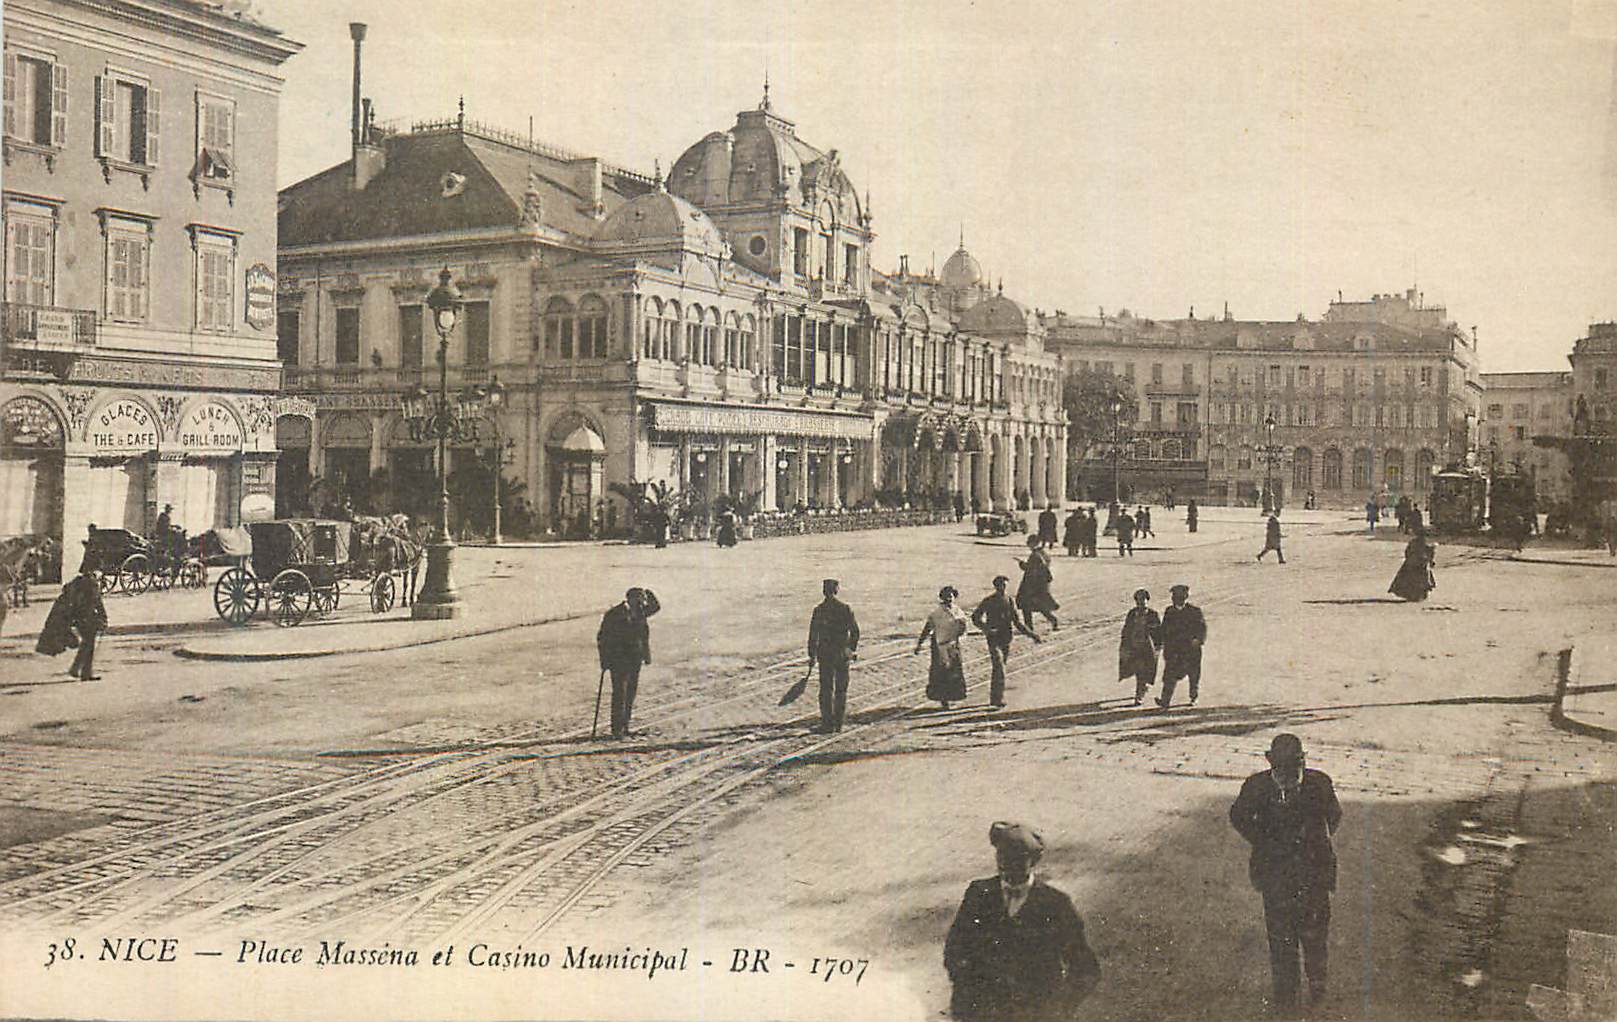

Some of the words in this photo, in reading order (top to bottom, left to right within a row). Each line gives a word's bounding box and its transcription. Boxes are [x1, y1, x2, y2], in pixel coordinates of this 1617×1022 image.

[100, 404, 148, 427] GLACES
[191, 407, 230, 426] LUNCH
[93, 433, 114, 446] THE
[127, 433, 155, 446] CAFE
